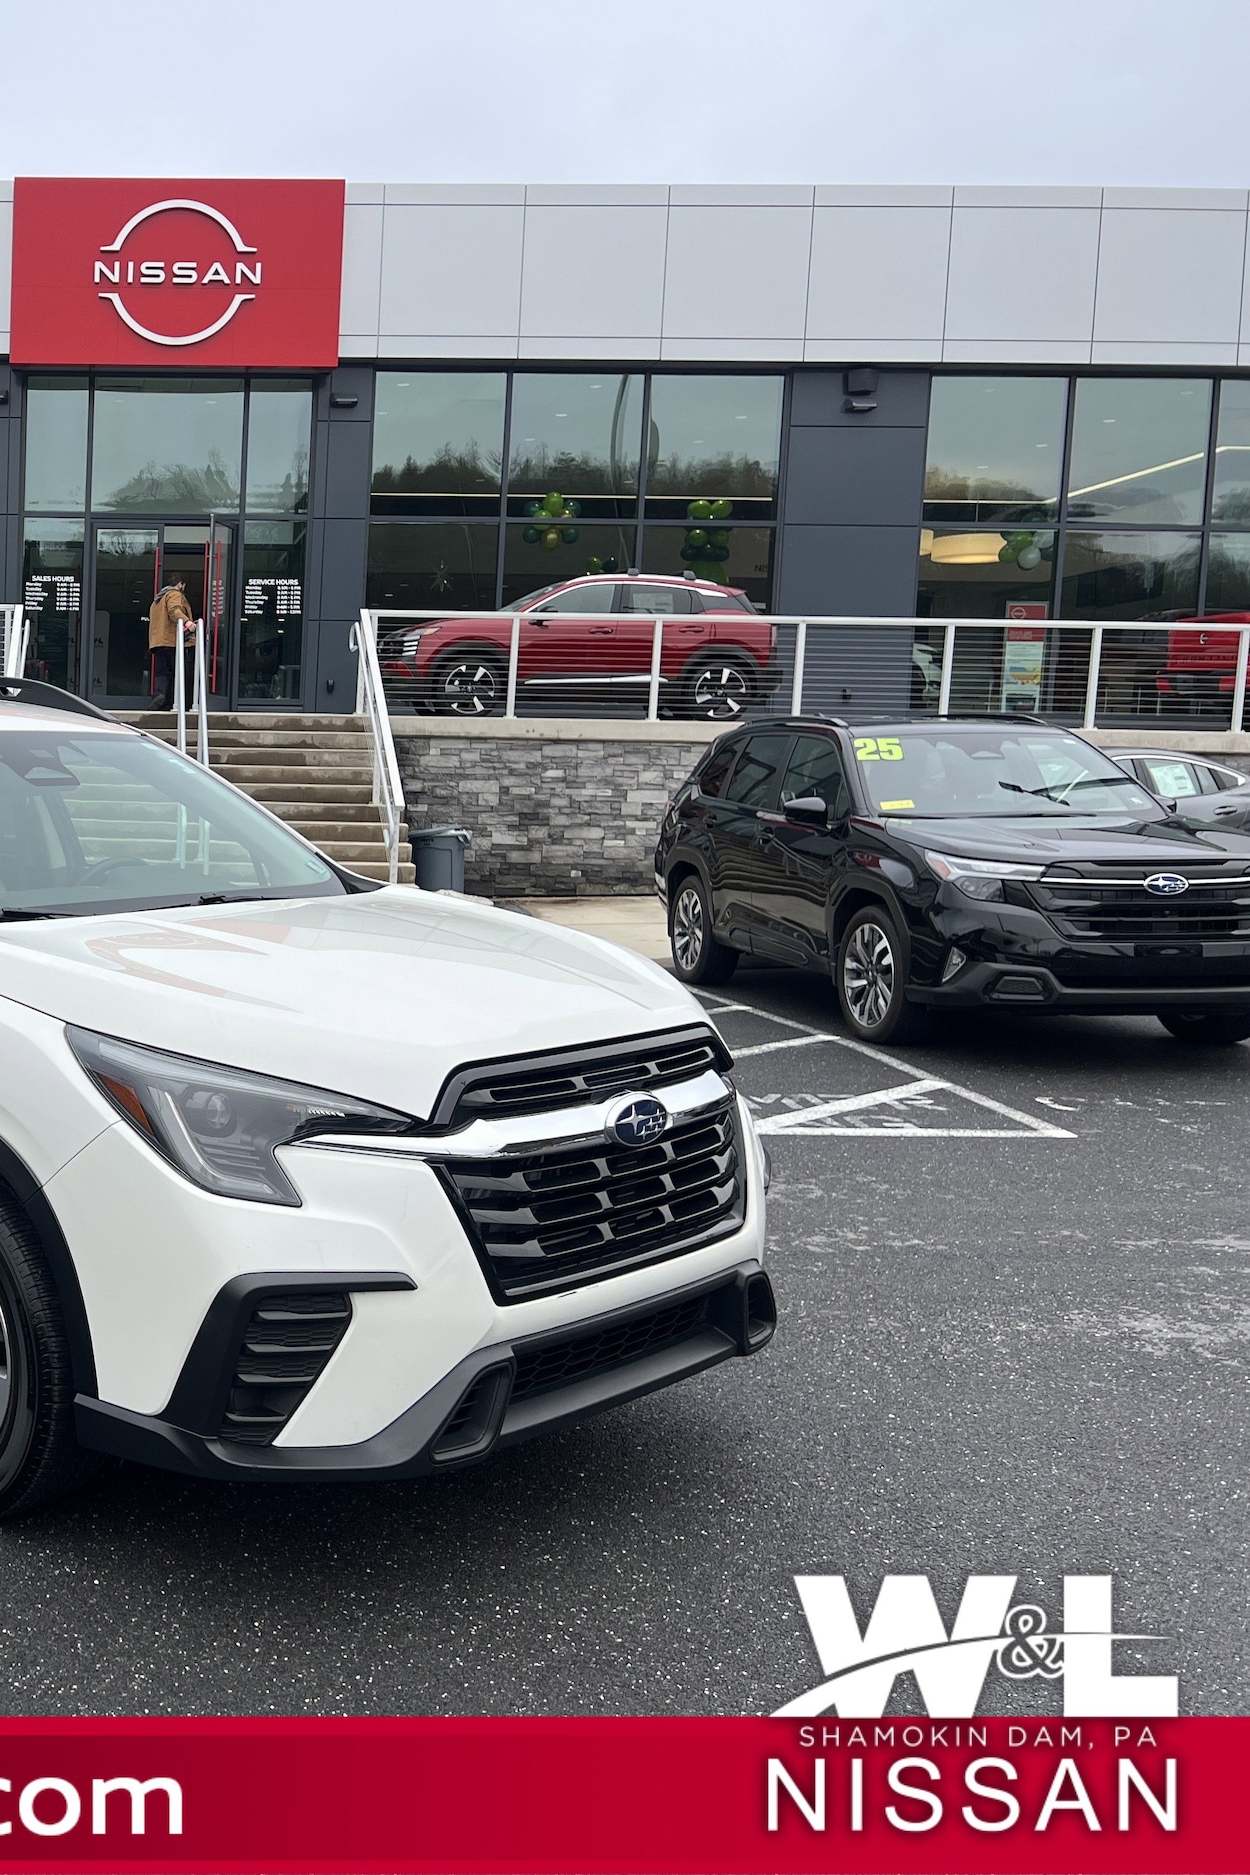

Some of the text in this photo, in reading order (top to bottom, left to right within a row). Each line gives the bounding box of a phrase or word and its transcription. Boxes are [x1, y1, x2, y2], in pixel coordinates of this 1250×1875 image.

[93, 260, 262, 285] NISSAN
[248, 578, 275, 586] SERVICE
[853, 737, 904, 761] 25
